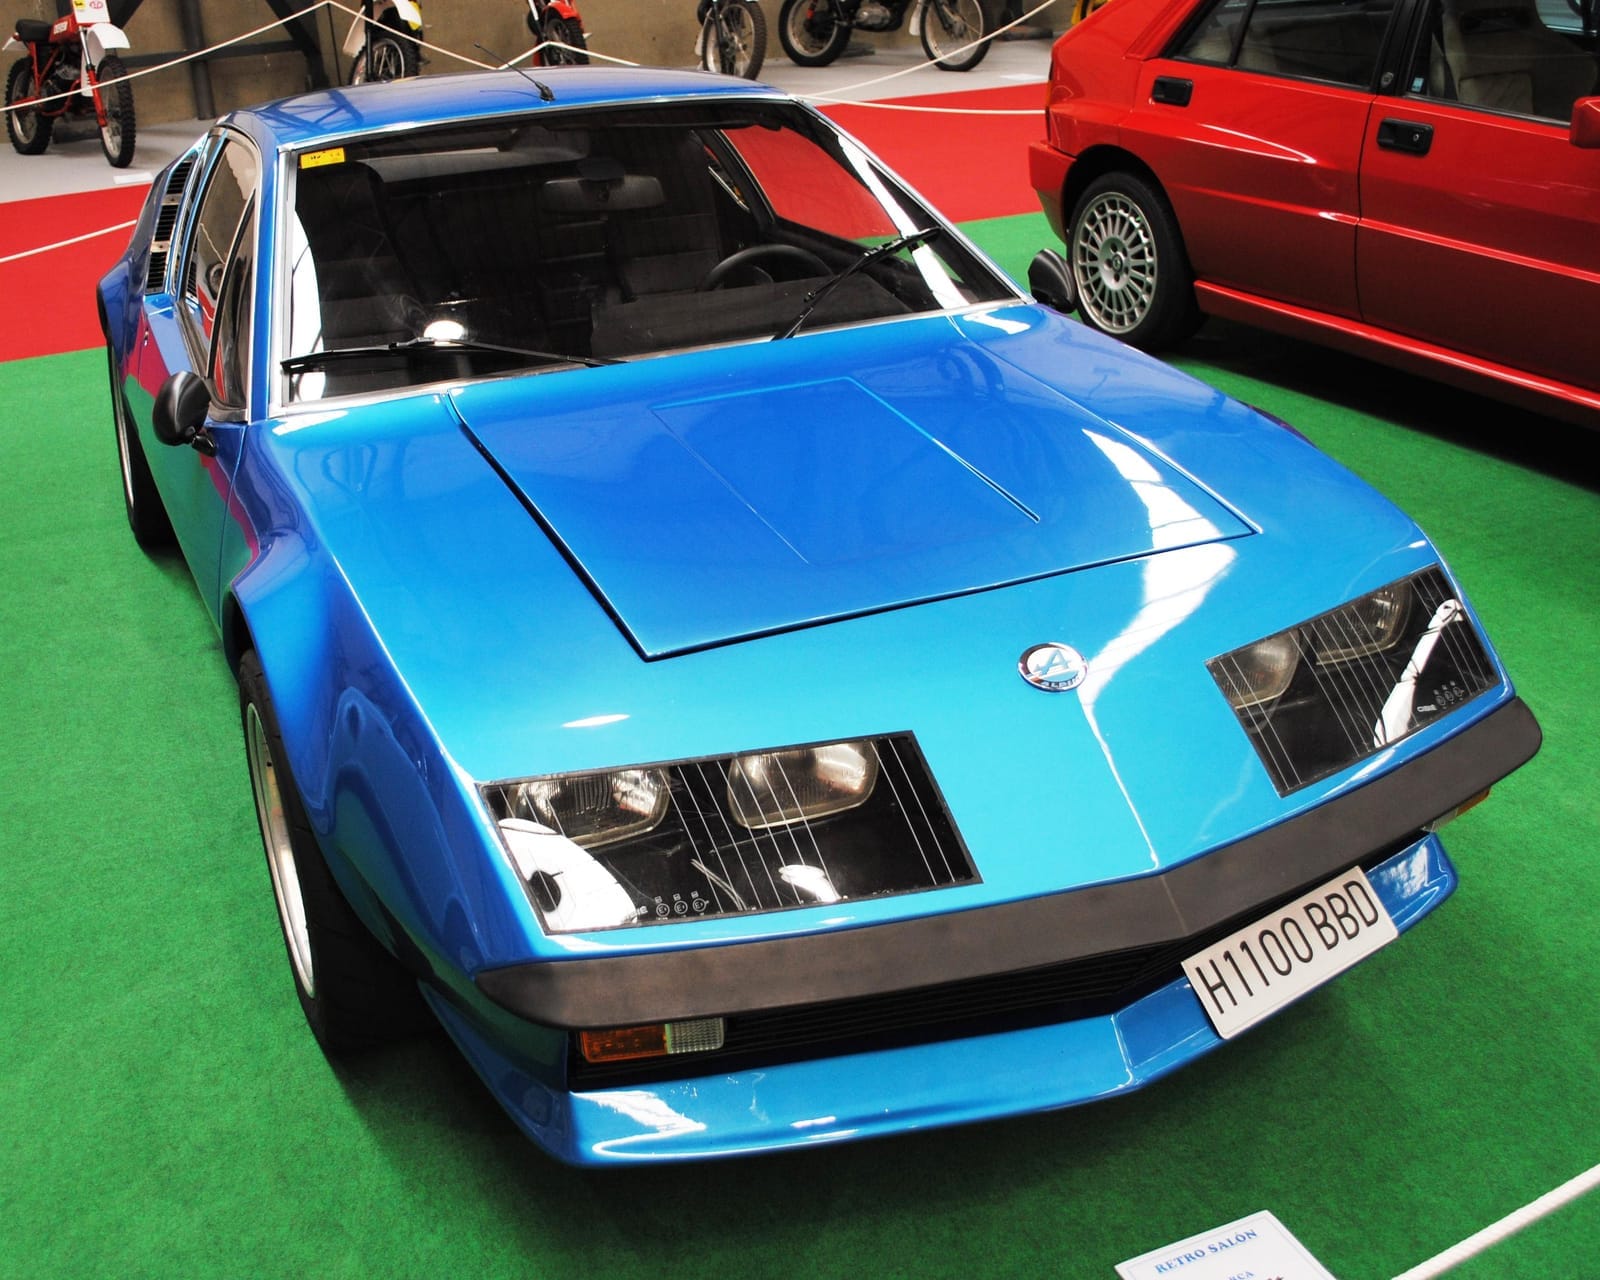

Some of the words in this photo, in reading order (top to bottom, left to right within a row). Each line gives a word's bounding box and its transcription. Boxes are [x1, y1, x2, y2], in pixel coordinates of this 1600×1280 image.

[1195, 916, 1314, 1015] H1100
[1303, 880, 1379, 951] BBD
[1155, 1249, 1206, 1273] RETRO
